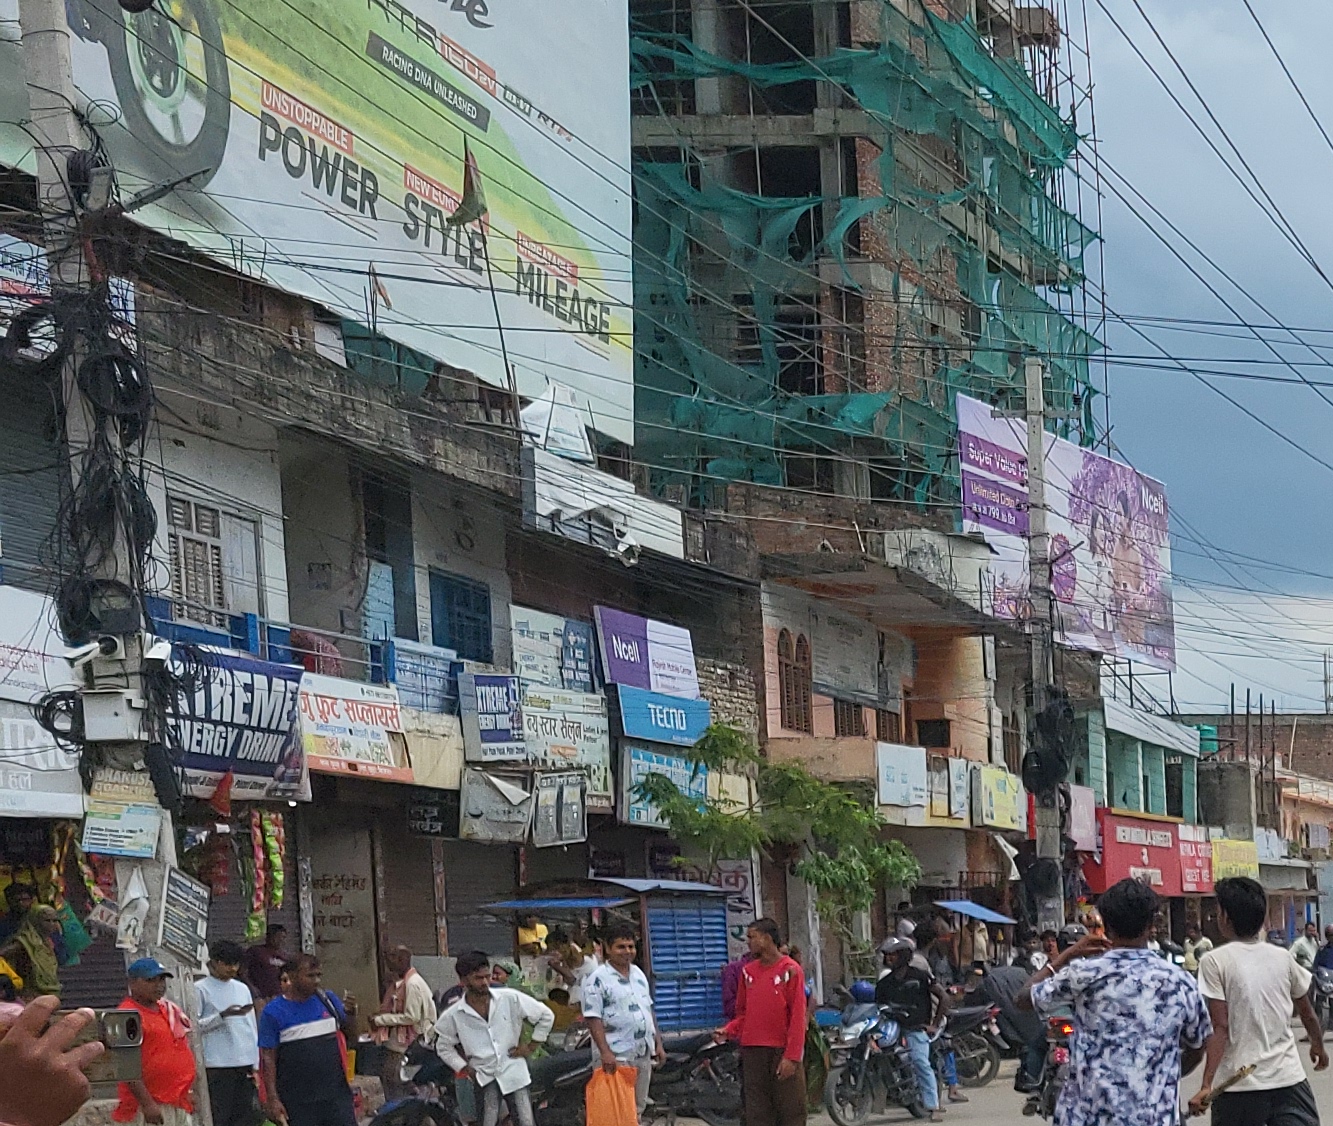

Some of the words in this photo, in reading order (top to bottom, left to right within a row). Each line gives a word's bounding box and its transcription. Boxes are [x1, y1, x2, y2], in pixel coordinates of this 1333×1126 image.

[382, 45, 413, 76] RACING
[414, 67, 432, 90] DNA
[433, 80, 477, 119] UNLEASHED
[263, 84, 348, 150] UNSTOPPABLE
[258, 110, 379, 221] POWER
[406, 170, 430, 196] NEW
[403, 192, 484, 276] STYLE
[516, 255, 611, 345] MILEAGE
[967, 442, 993, 467] Super
[994, 452, 1017, 477] Value
[1141, 491, 1165, 516] Ncell
[612, 633, 641, 663] Ncell
[476, 686, 508, 713] XTREME
[647, 702, 687, 731] TECNO
[237, 729, 287, 764] DRINK
